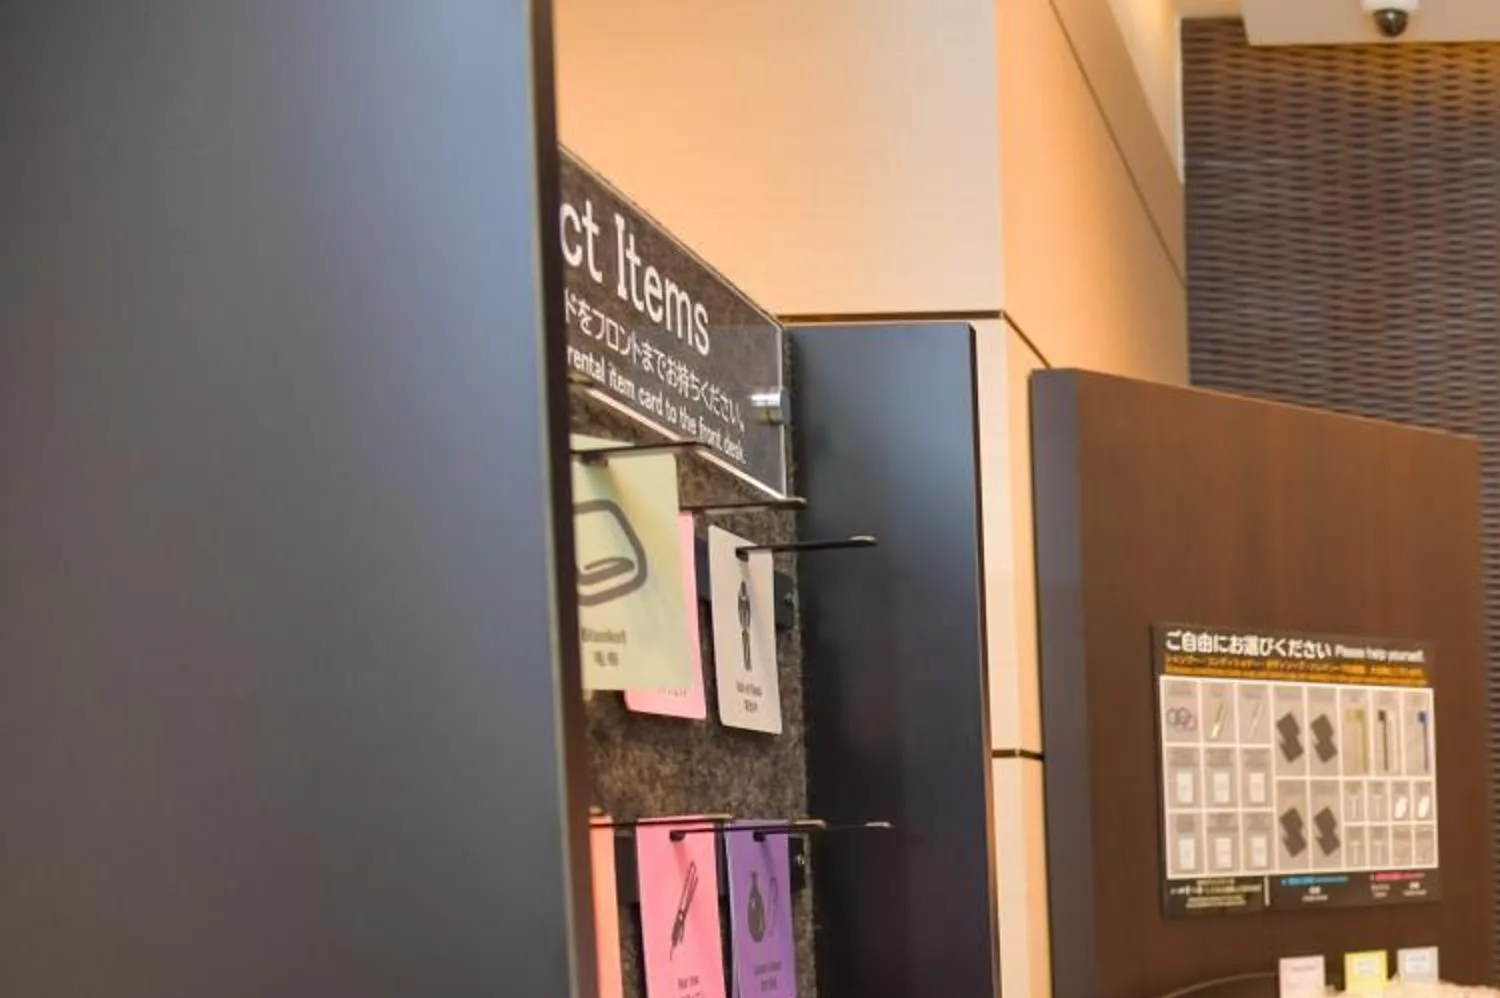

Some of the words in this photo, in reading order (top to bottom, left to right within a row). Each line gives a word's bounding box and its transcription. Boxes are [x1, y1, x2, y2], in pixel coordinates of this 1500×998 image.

[614, 212, 711, 356] Items
[567, 345, 606, 383] rental
[608, 361, 636, 400] item
[637, 387, 663, 417] card
[665, 398, 678, 425] to
[679, 404, 697, 436] the
[699, 415, 723, 451] front
[1165, 628, 1333, 660] ご自由にお選びください
